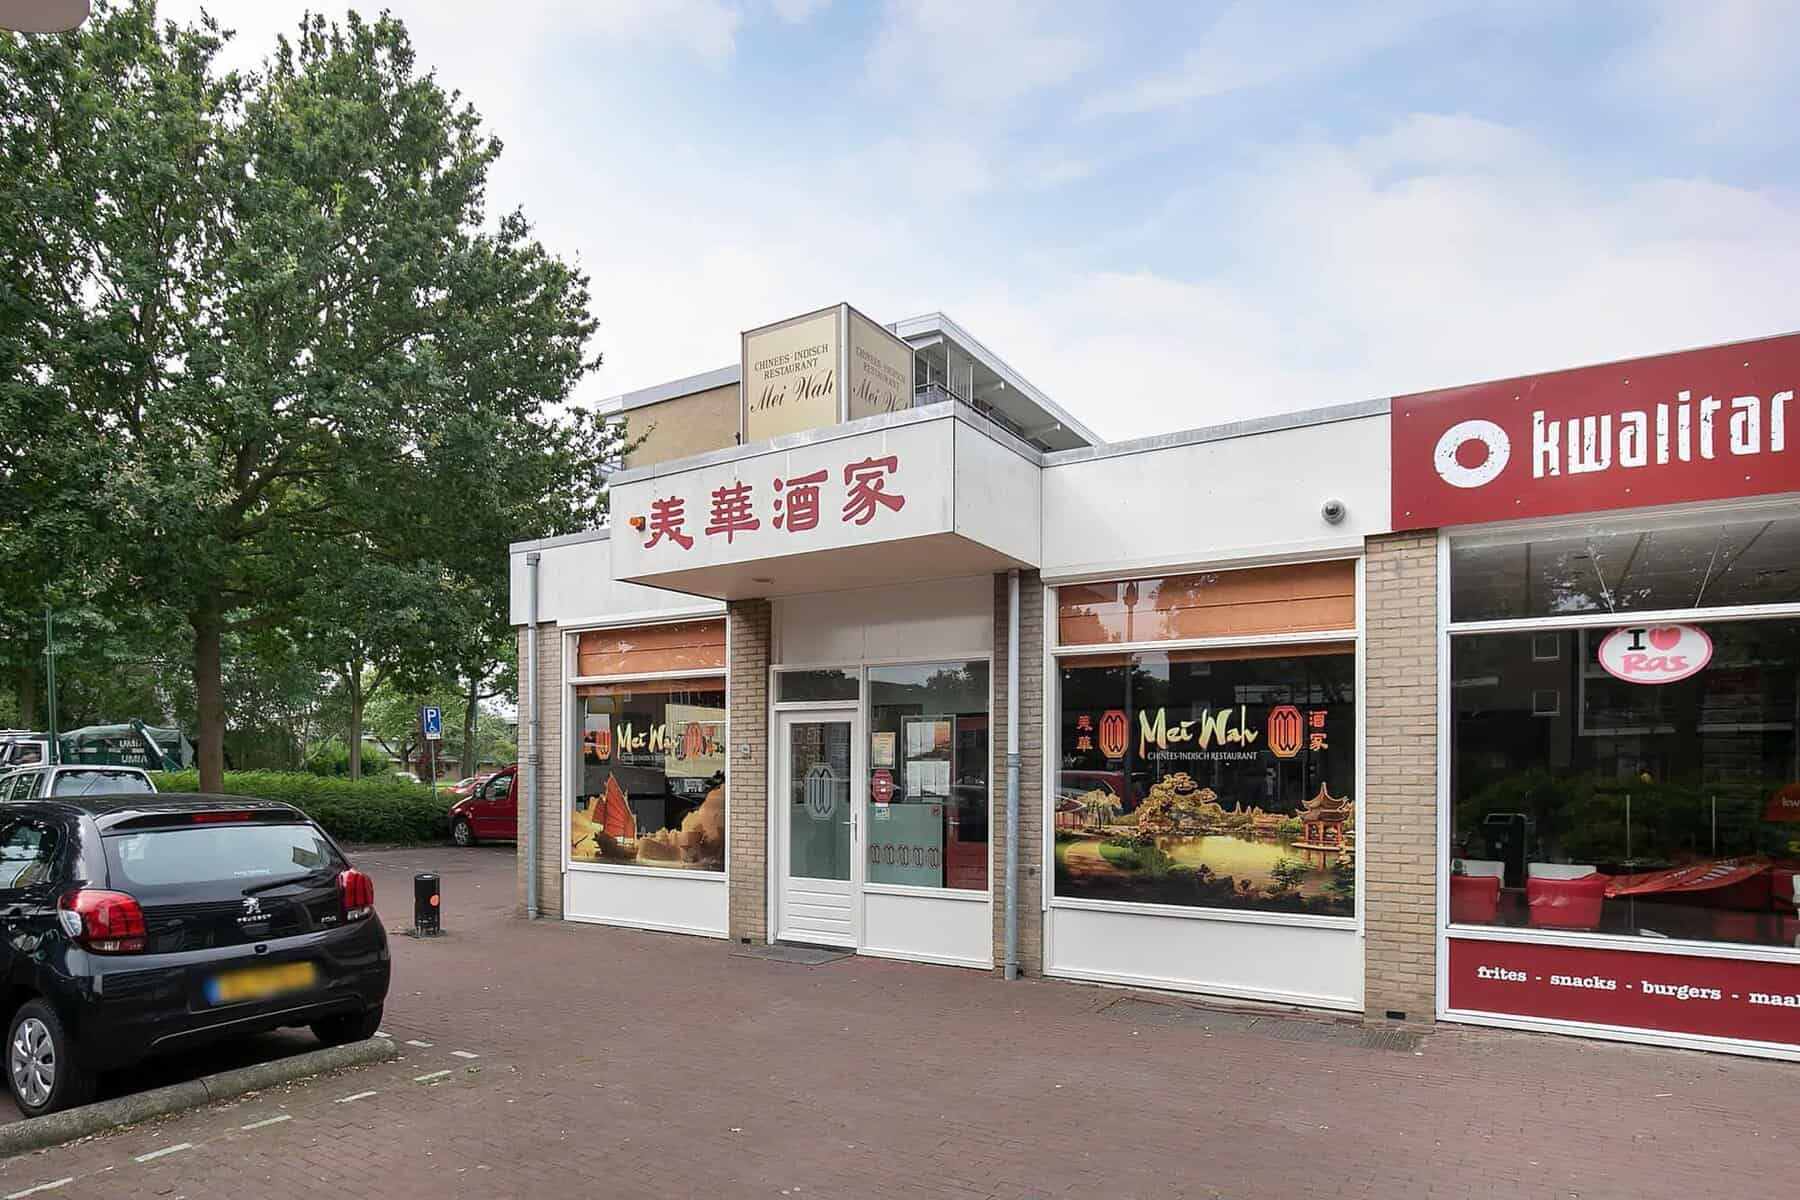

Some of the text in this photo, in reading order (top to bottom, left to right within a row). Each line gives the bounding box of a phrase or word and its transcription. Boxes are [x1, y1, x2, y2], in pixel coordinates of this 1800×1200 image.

[764, 357, 817, 380] RESTAURANT
[750, 369, 833, 412] Mei Wah
[1532, 389, 1794, 479] kwalitar
[644, 455, 905, 551] 美華酒家
[1627, 628, 1646, 651] I
[1620, 653, 1689, 674] Ras
[427, 709, 437, 722] P
[1138, 704, 1259, 759] Mei Wah
[616, 722, 647, 761] Mei
[1210, 751, 1258, 760] RESTAURANT
[1477, 965, 1527, 982] frites
[1550, 974, 1617, 990] snacks
[1641, 980, 1721, 1000] burgers
